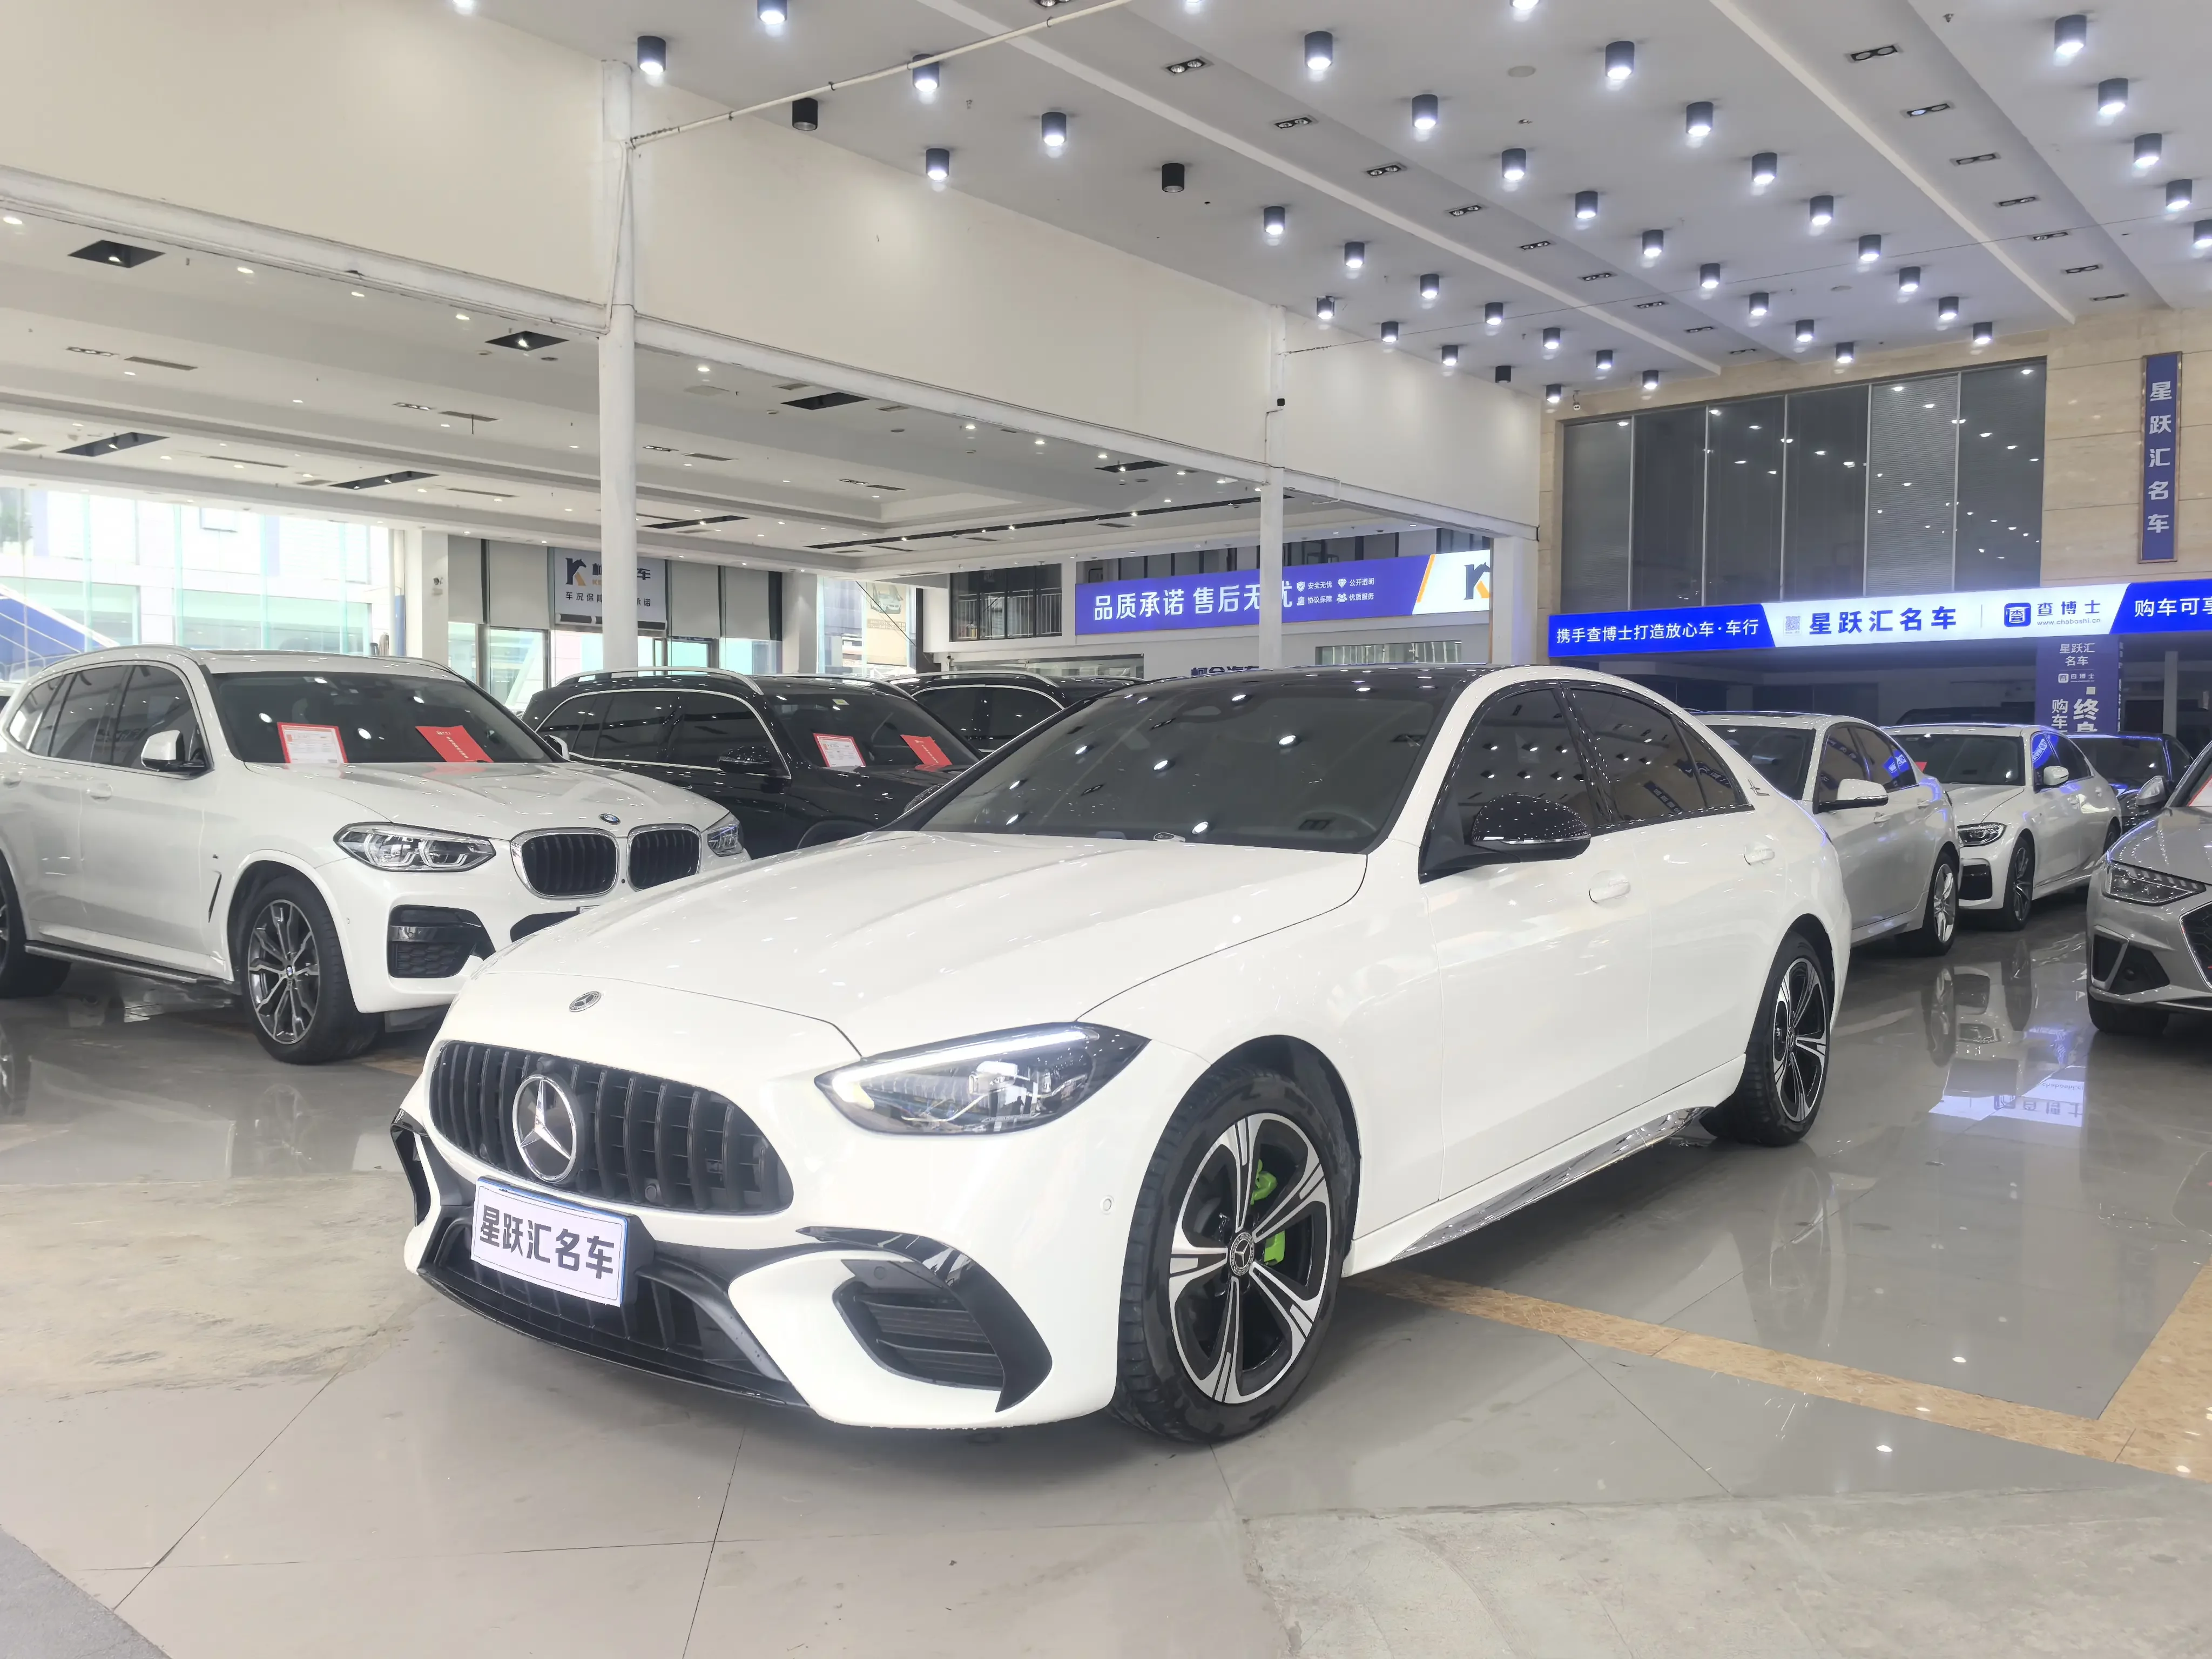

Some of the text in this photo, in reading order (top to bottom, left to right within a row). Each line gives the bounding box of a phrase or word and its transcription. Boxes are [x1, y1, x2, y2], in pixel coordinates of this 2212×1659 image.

[2147, 381, 2172, 533] 星跃汇名车
[1307, 581, 1332, 590] 安全无忧
[1349, 578, 1375, 586] 公开透明
[1307, 596, 1332, 604] 协议保障
[1348, 592, 1374, 601] 优质服务
[1094, 589, 1185, 621] 品质承诺
[2037, 599, 2101, 616] 查博士
[1809, 606, 1957, 635] 星跃汇名车
[2060, 643, 2095, 654] 星跃汇
[2065, 656, 2088, 666] 名车
[2051, 699, 2068, 732] 购车
[480, 1205, 615, 1279] 星跃汇名车
